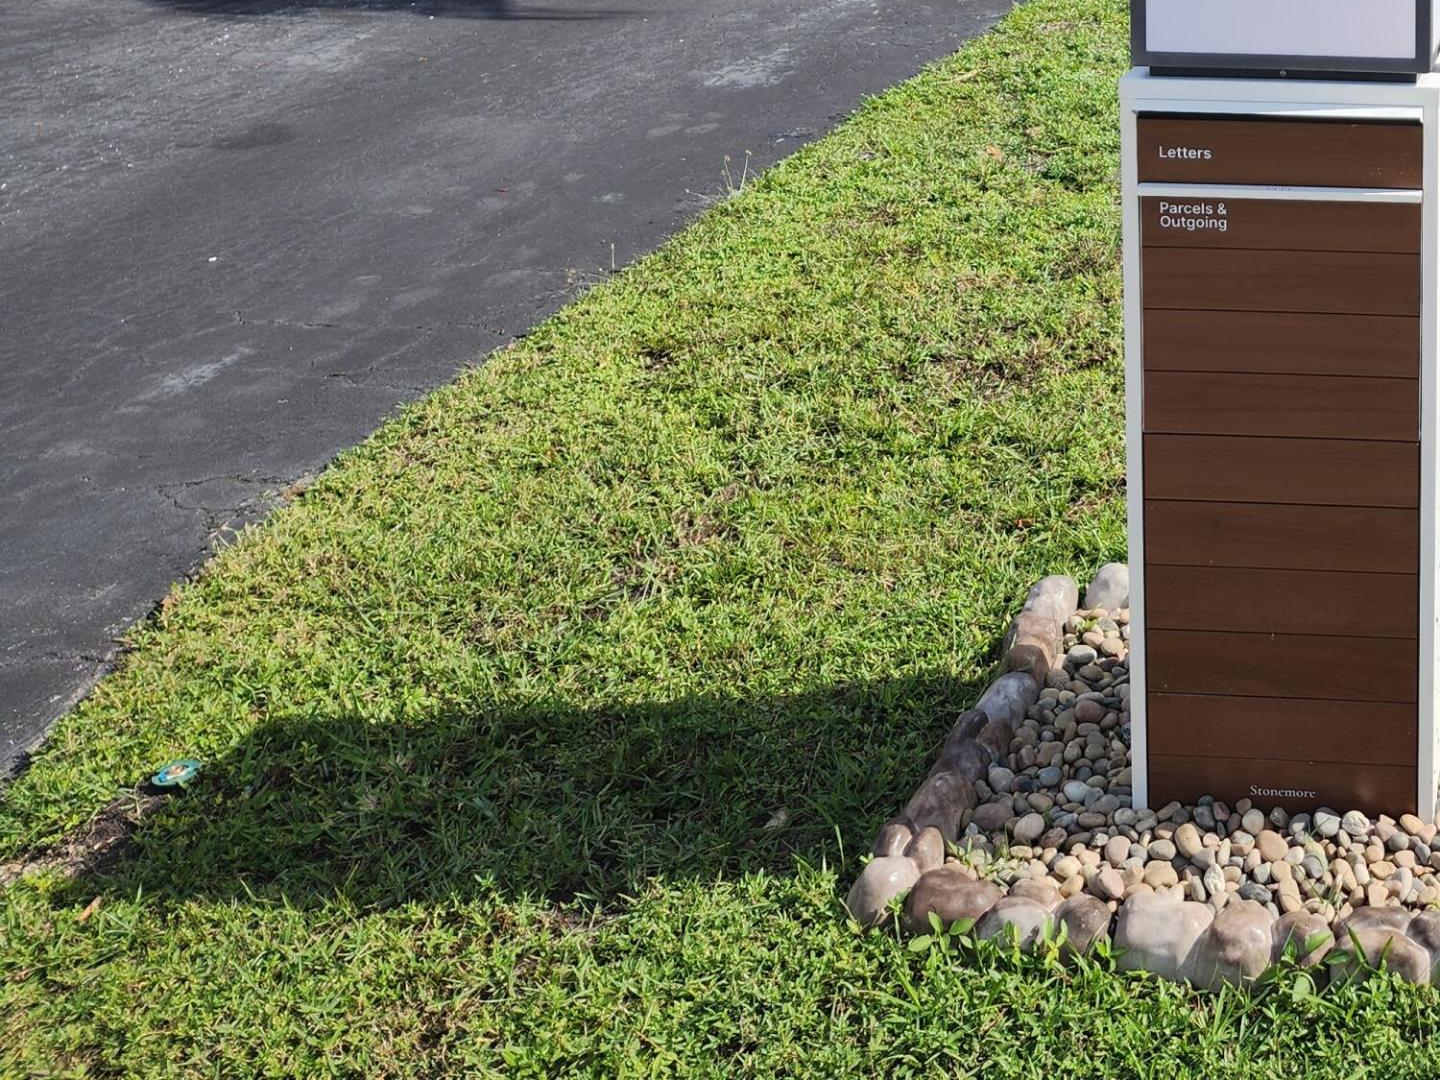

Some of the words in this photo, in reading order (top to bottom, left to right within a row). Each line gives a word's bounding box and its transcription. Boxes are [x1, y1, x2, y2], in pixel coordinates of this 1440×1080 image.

[1159, 145, 1212, 159] Letters
[1159, 201, 1214, 215] Parcels
[1217, 202, 1227, 215] &
[1160, 215, 1227, 231] Outgoing
[1249, 784, 1317, 799] Stonemore
